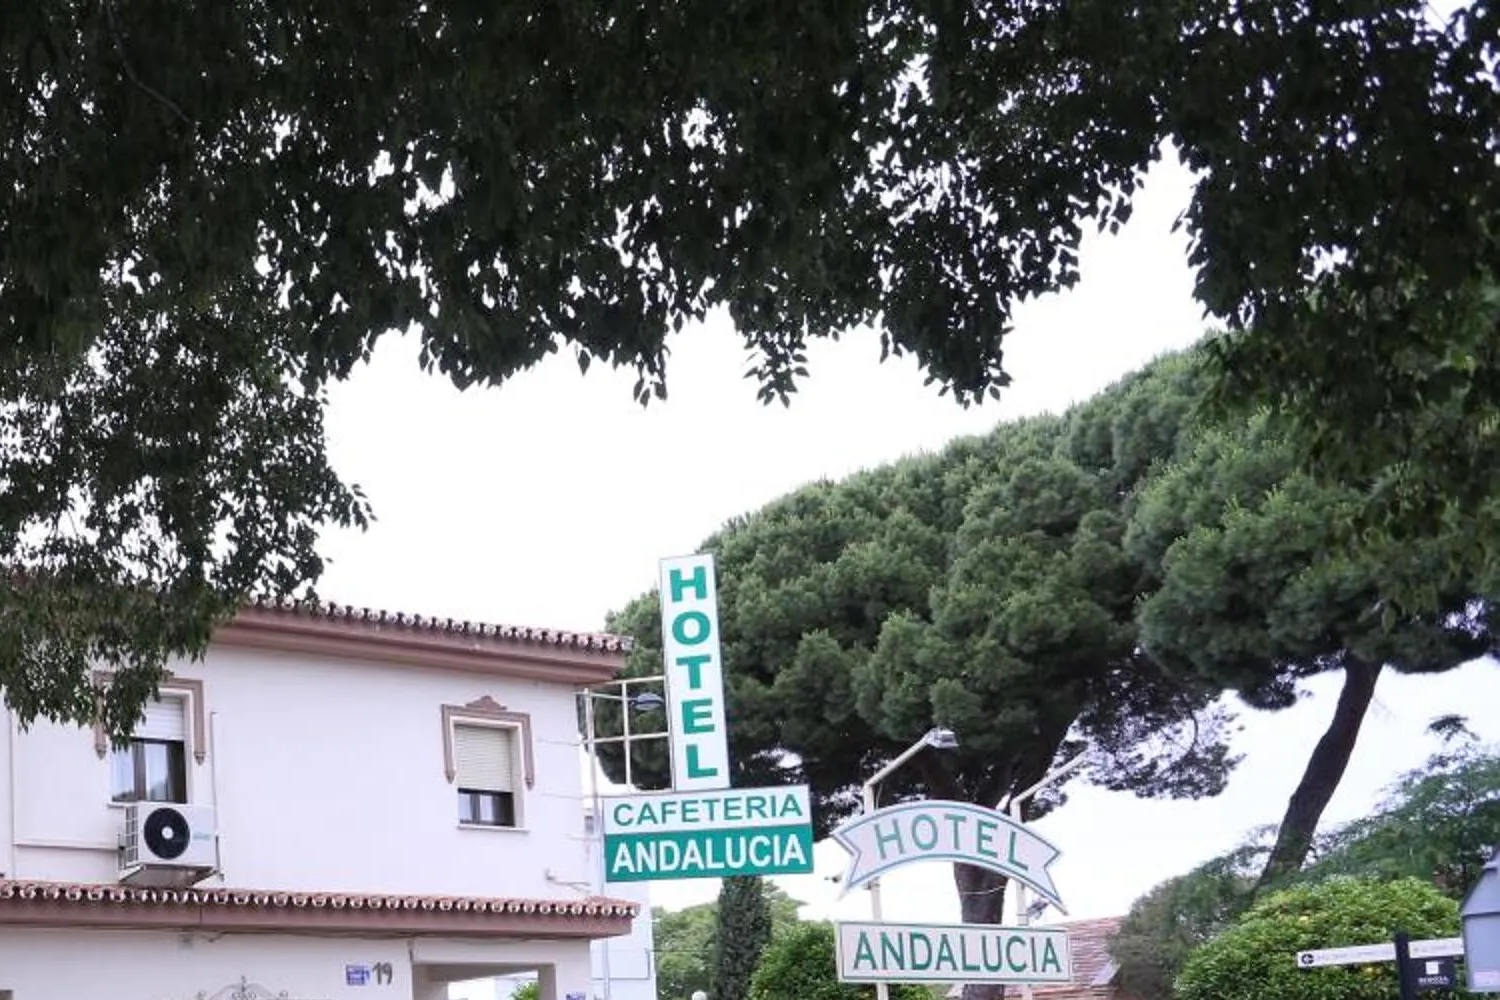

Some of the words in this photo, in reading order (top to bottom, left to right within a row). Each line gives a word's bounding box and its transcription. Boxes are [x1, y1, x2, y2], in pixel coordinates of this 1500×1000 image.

[668, 565, 718, 780] HOTEL
[612, 793, 804, 827] CAFETERIA
[611, 833, 807, 874] ANDALUCIA
[874, 812, 1030, 872] HOTEL
[371, 961, 393, 986] 19
[852, 931, 1062, 974] ANDALUCIA
